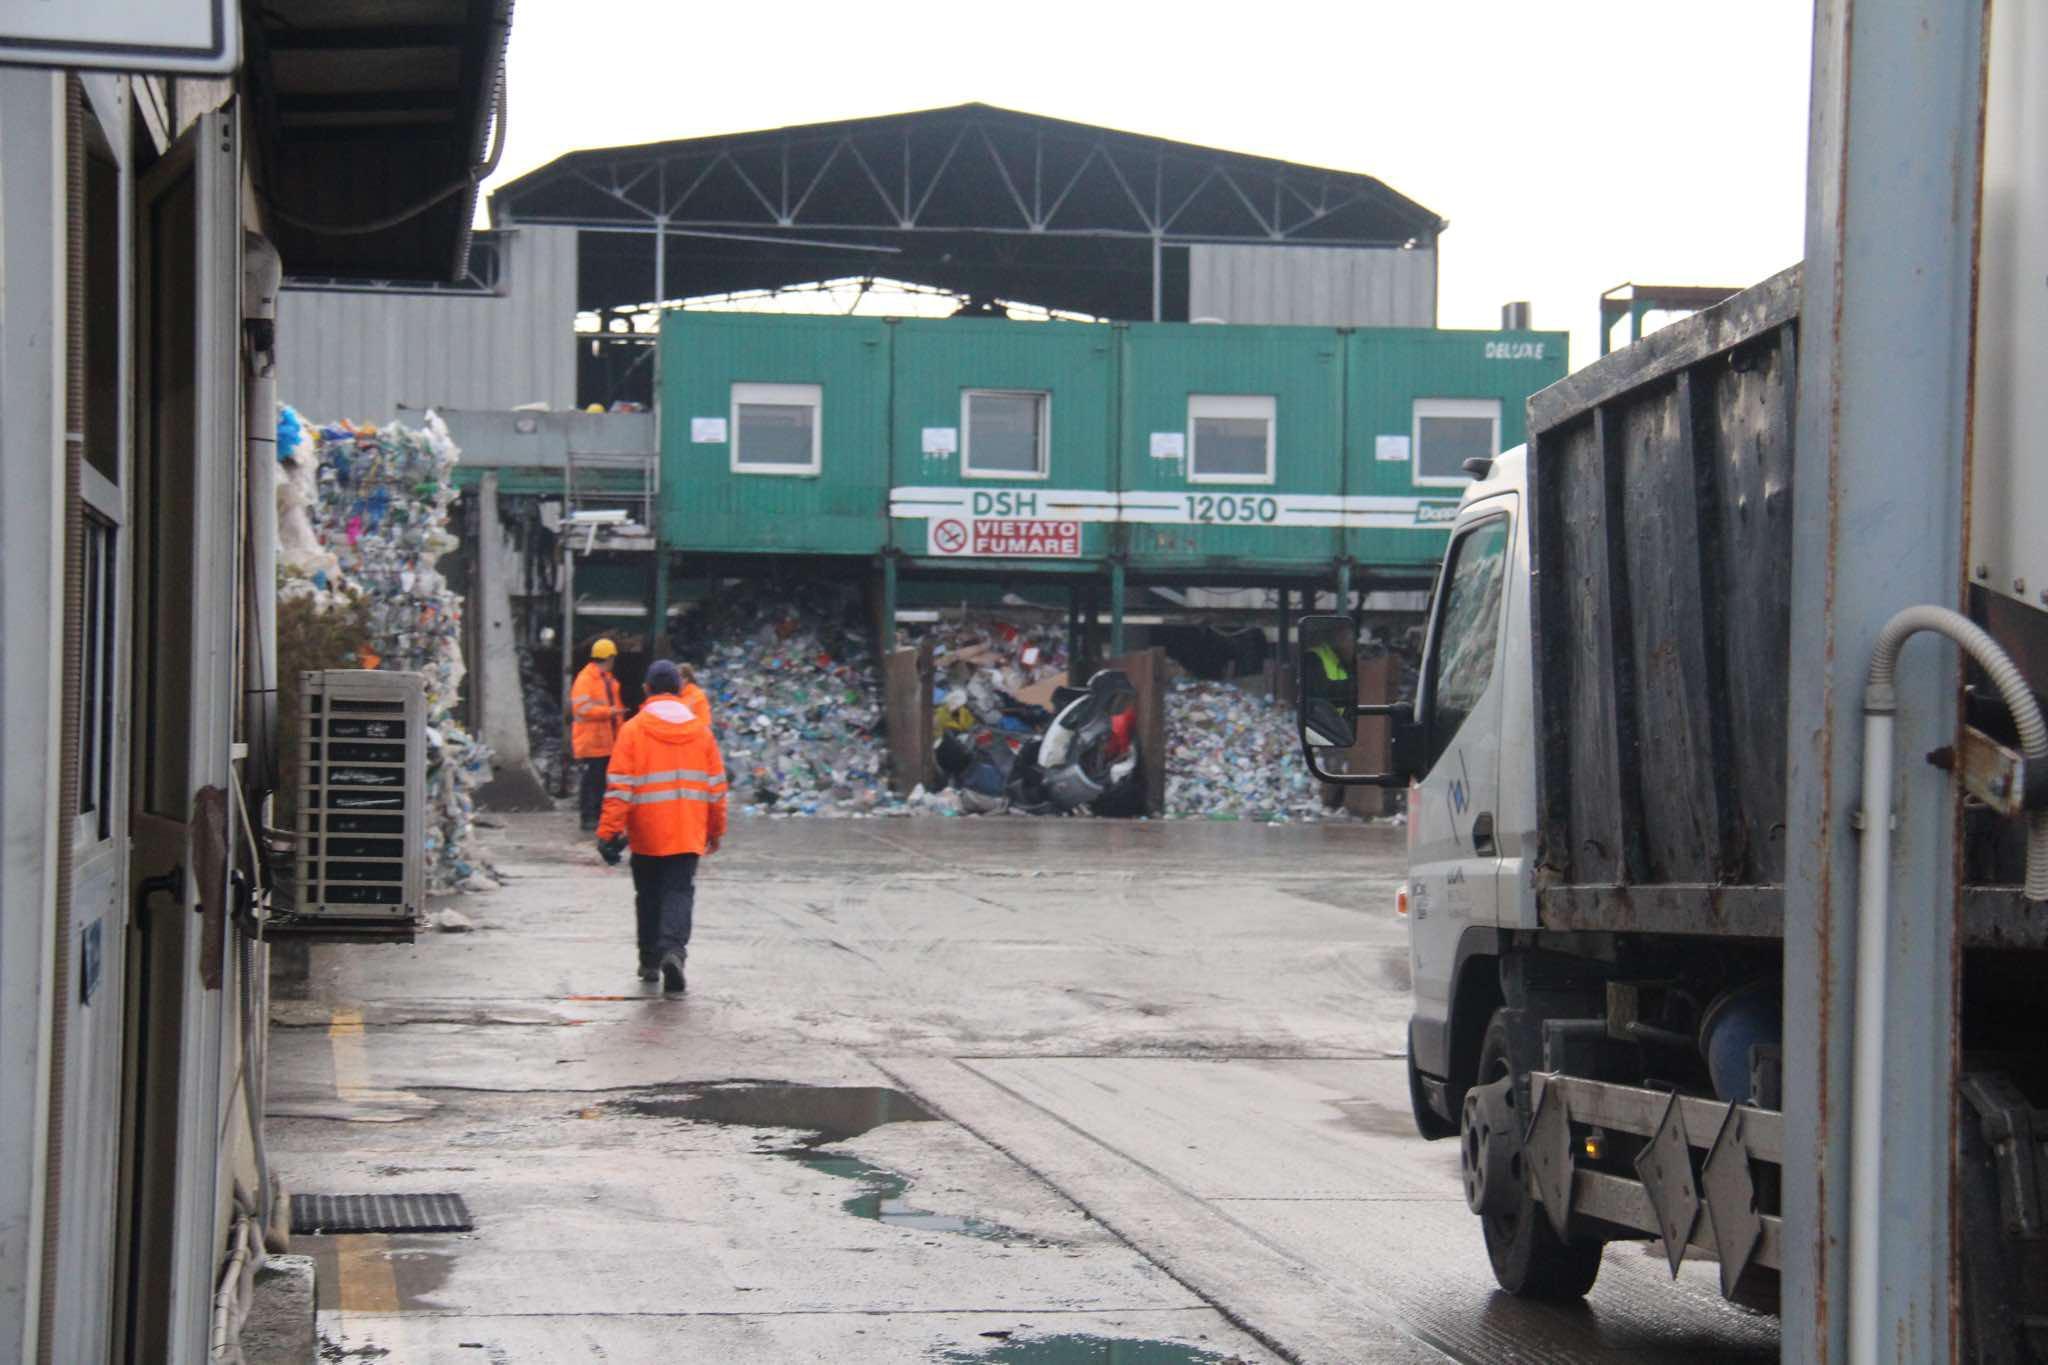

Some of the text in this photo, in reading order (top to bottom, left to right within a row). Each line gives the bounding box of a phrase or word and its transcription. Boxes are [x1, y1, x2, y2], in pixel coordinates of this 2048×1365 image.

[973, 492, 1037, 516] DSH
[1185, 496, 1277, 522] 12050
[976, 522, 1076, 537] VIETATO
[976, 538, 1075, 553] FUMARE
